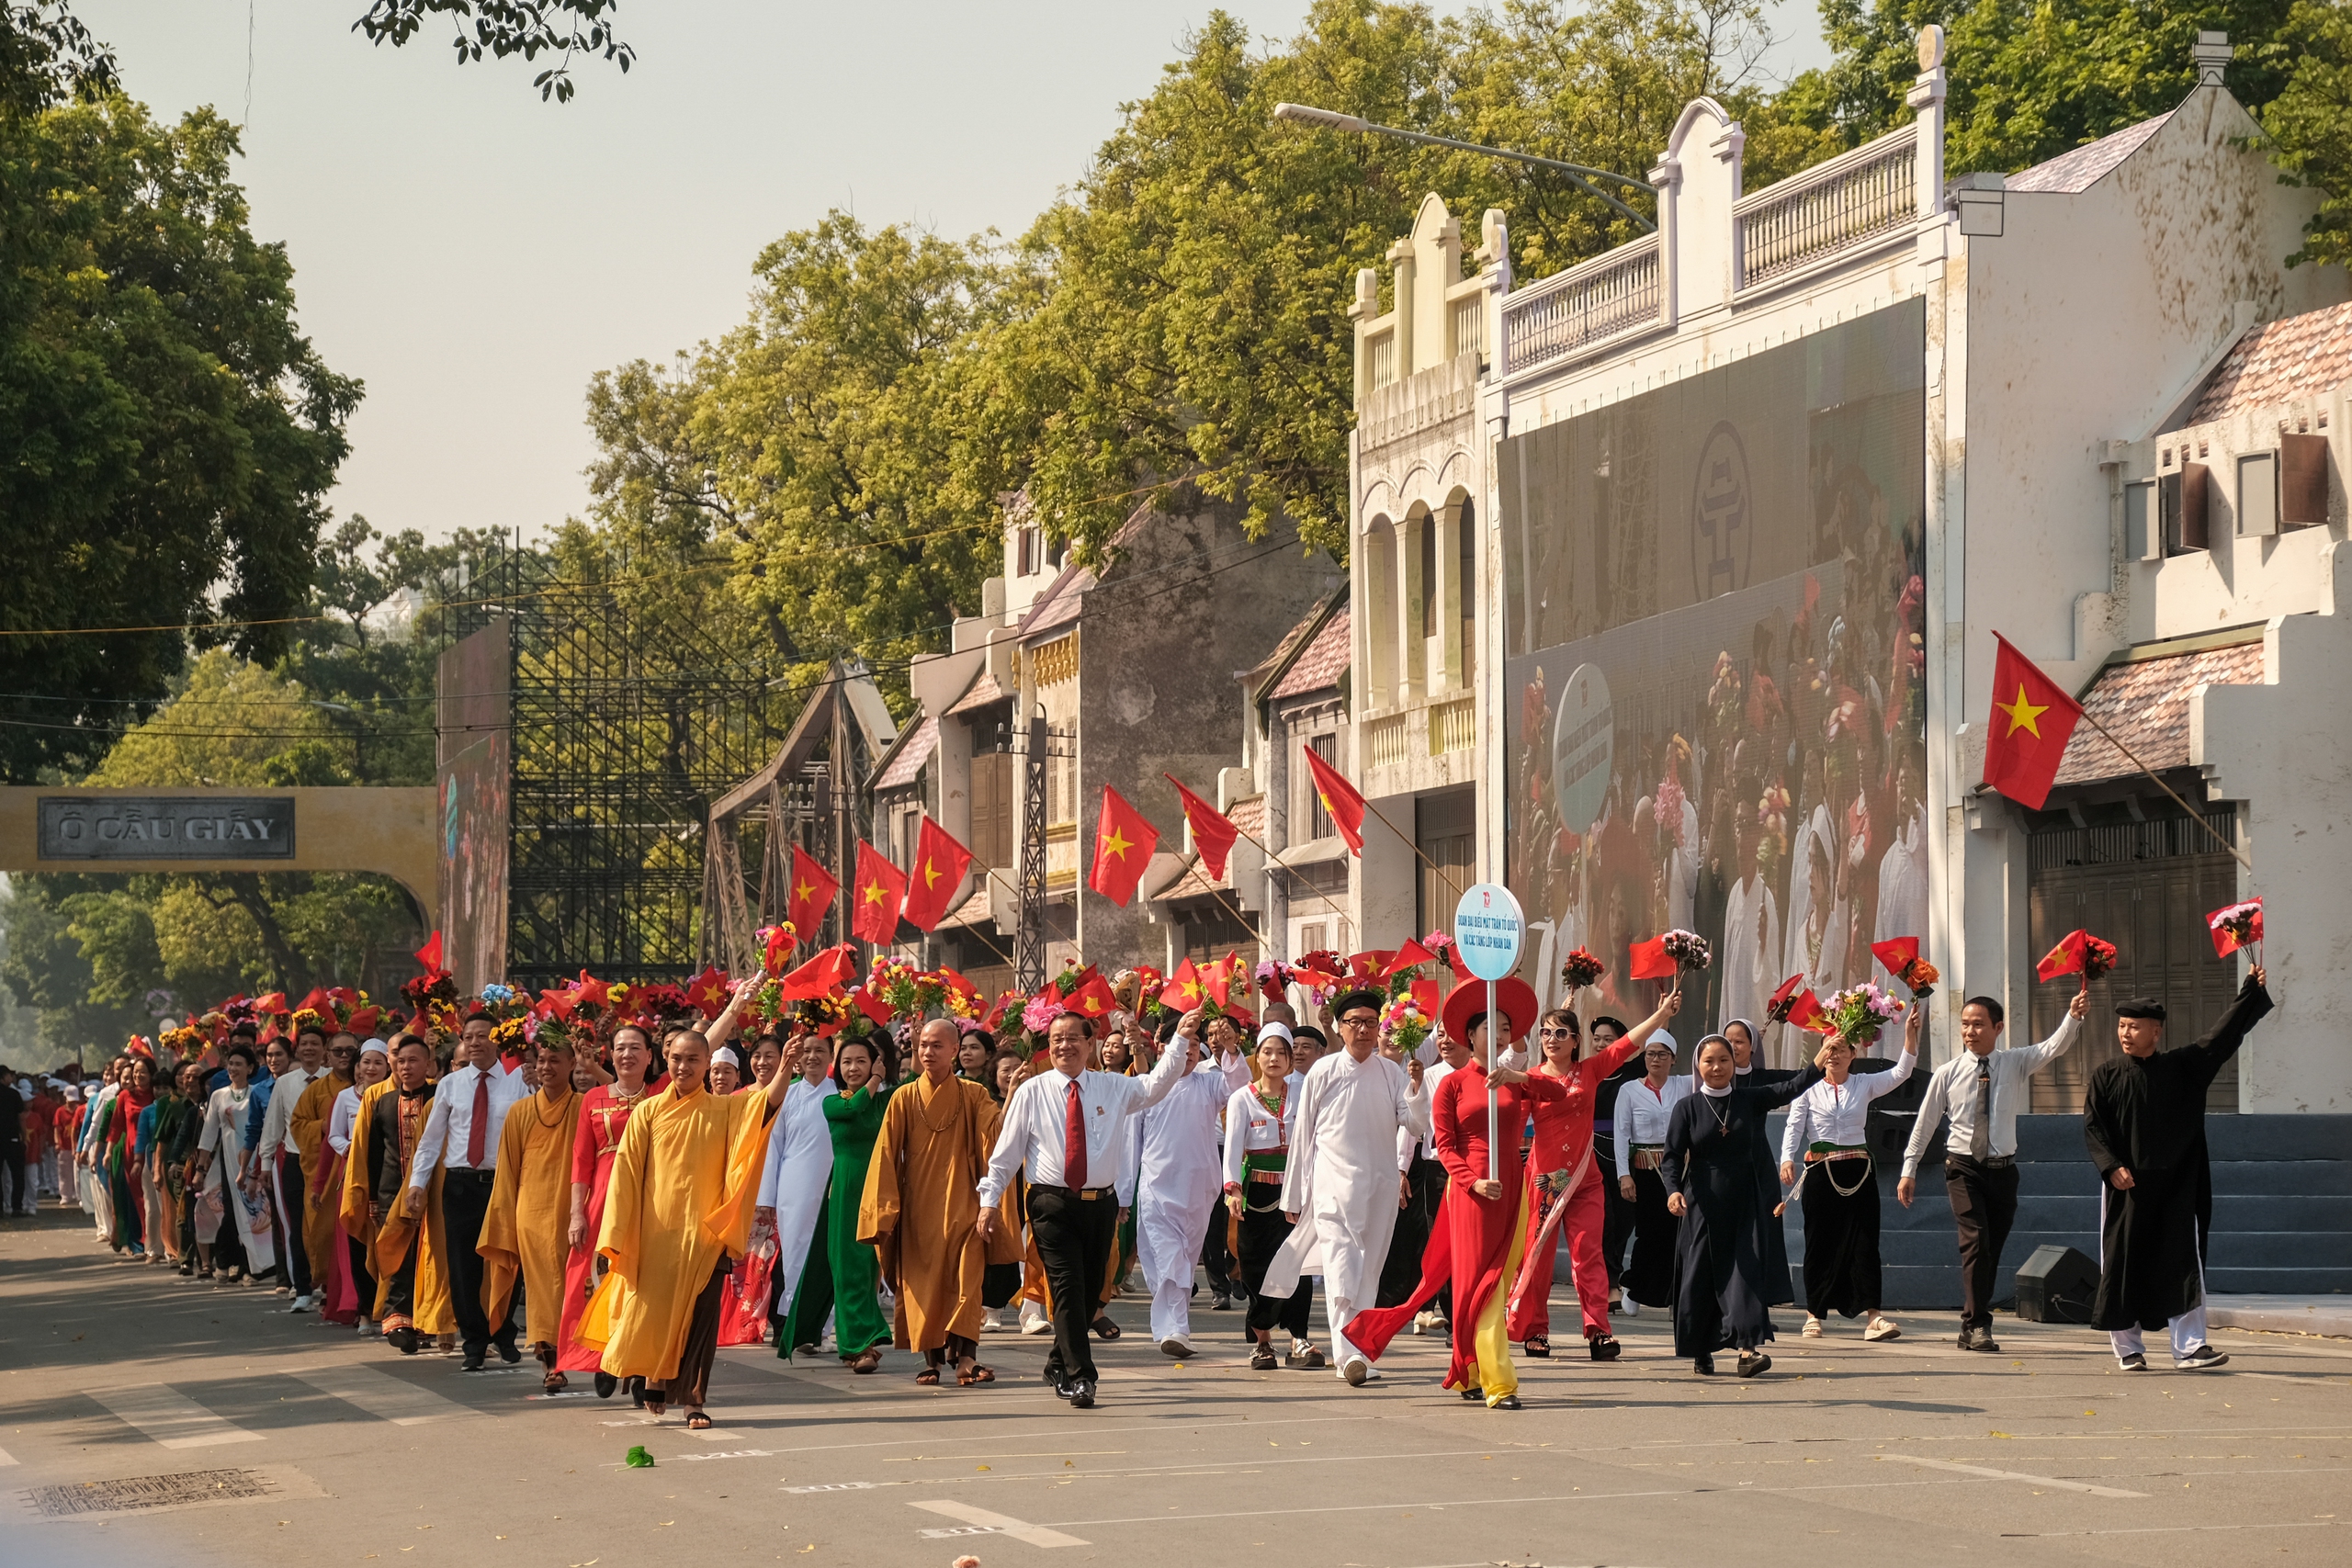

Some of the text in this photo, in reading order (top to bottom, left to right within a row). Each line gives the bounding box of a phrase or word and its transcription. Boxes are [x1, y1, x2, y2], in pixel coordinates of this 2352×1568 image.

[59, 808, 275, 840] Ô CẦU GIẤY
